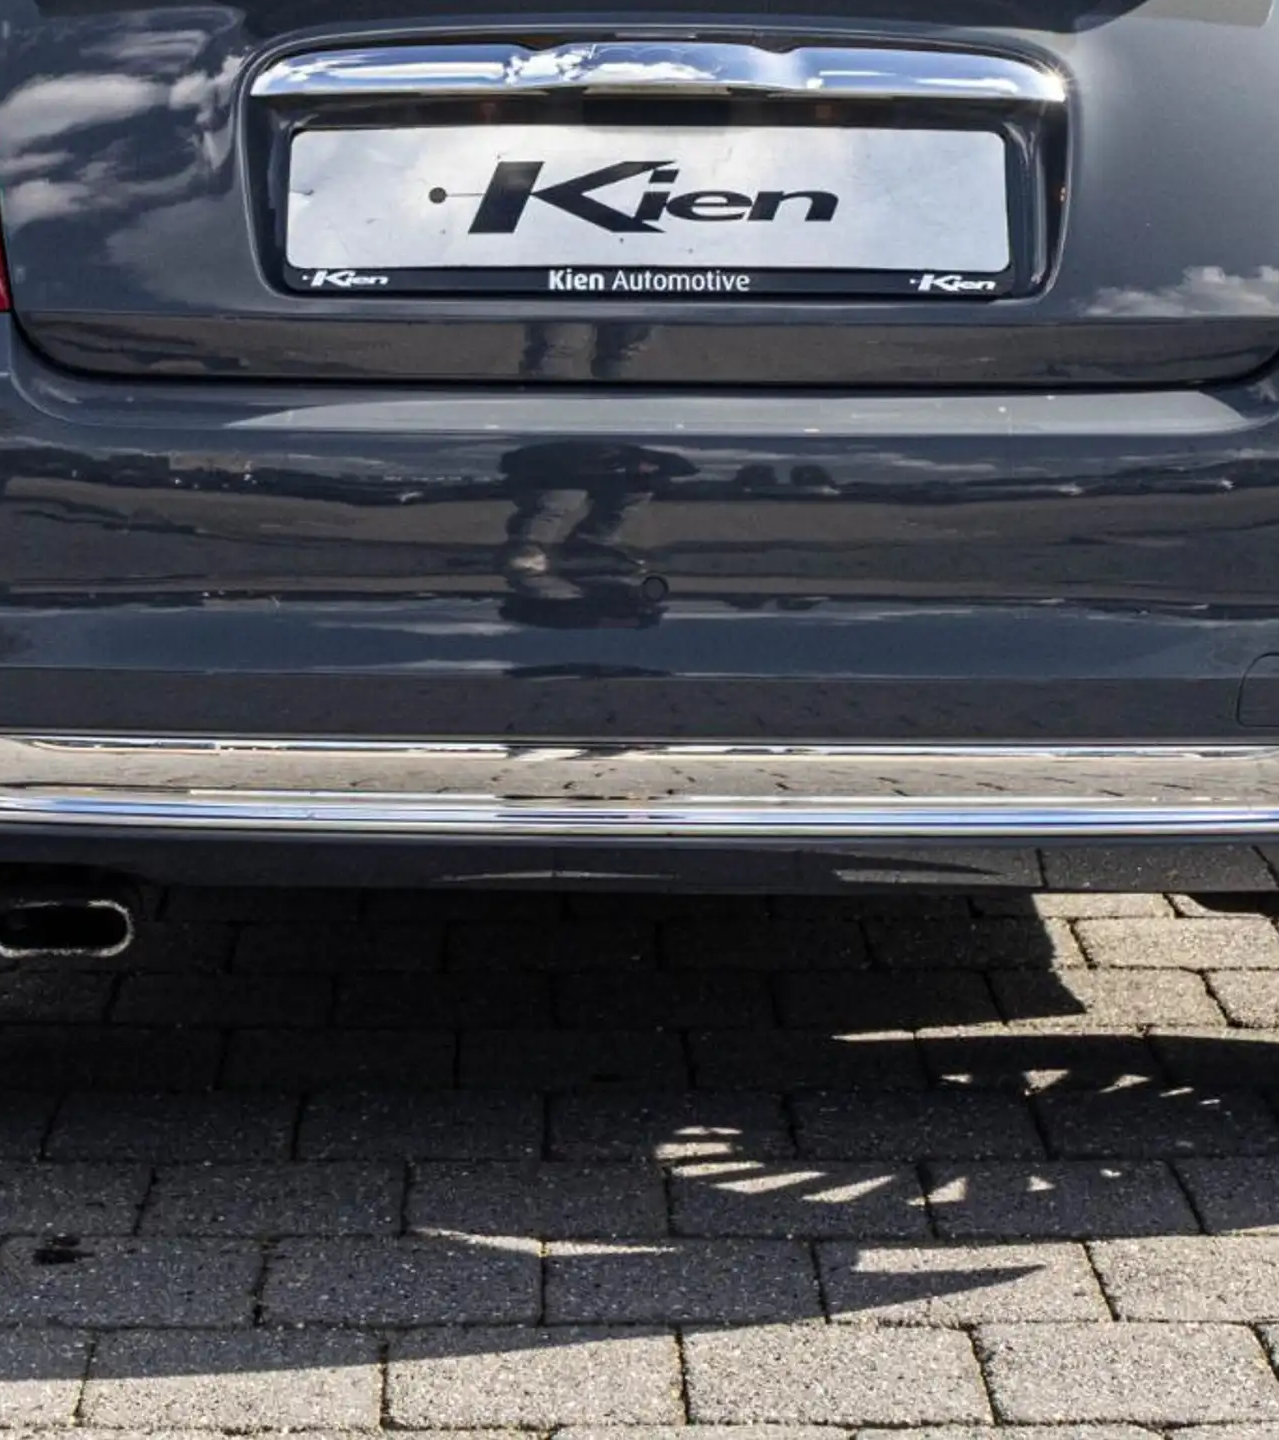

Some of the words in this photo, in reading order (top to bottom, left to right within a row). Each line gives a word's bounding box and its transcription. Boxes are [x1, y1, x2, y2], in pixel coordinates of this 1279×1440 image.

[468, 161, 839, 234] Kien
[310, 269, 390, 288] Kien
[548, 268, 605, 291] Kien
[611, 269, 751, 292] Automotive
[917, 273, 996, 292] Kien
